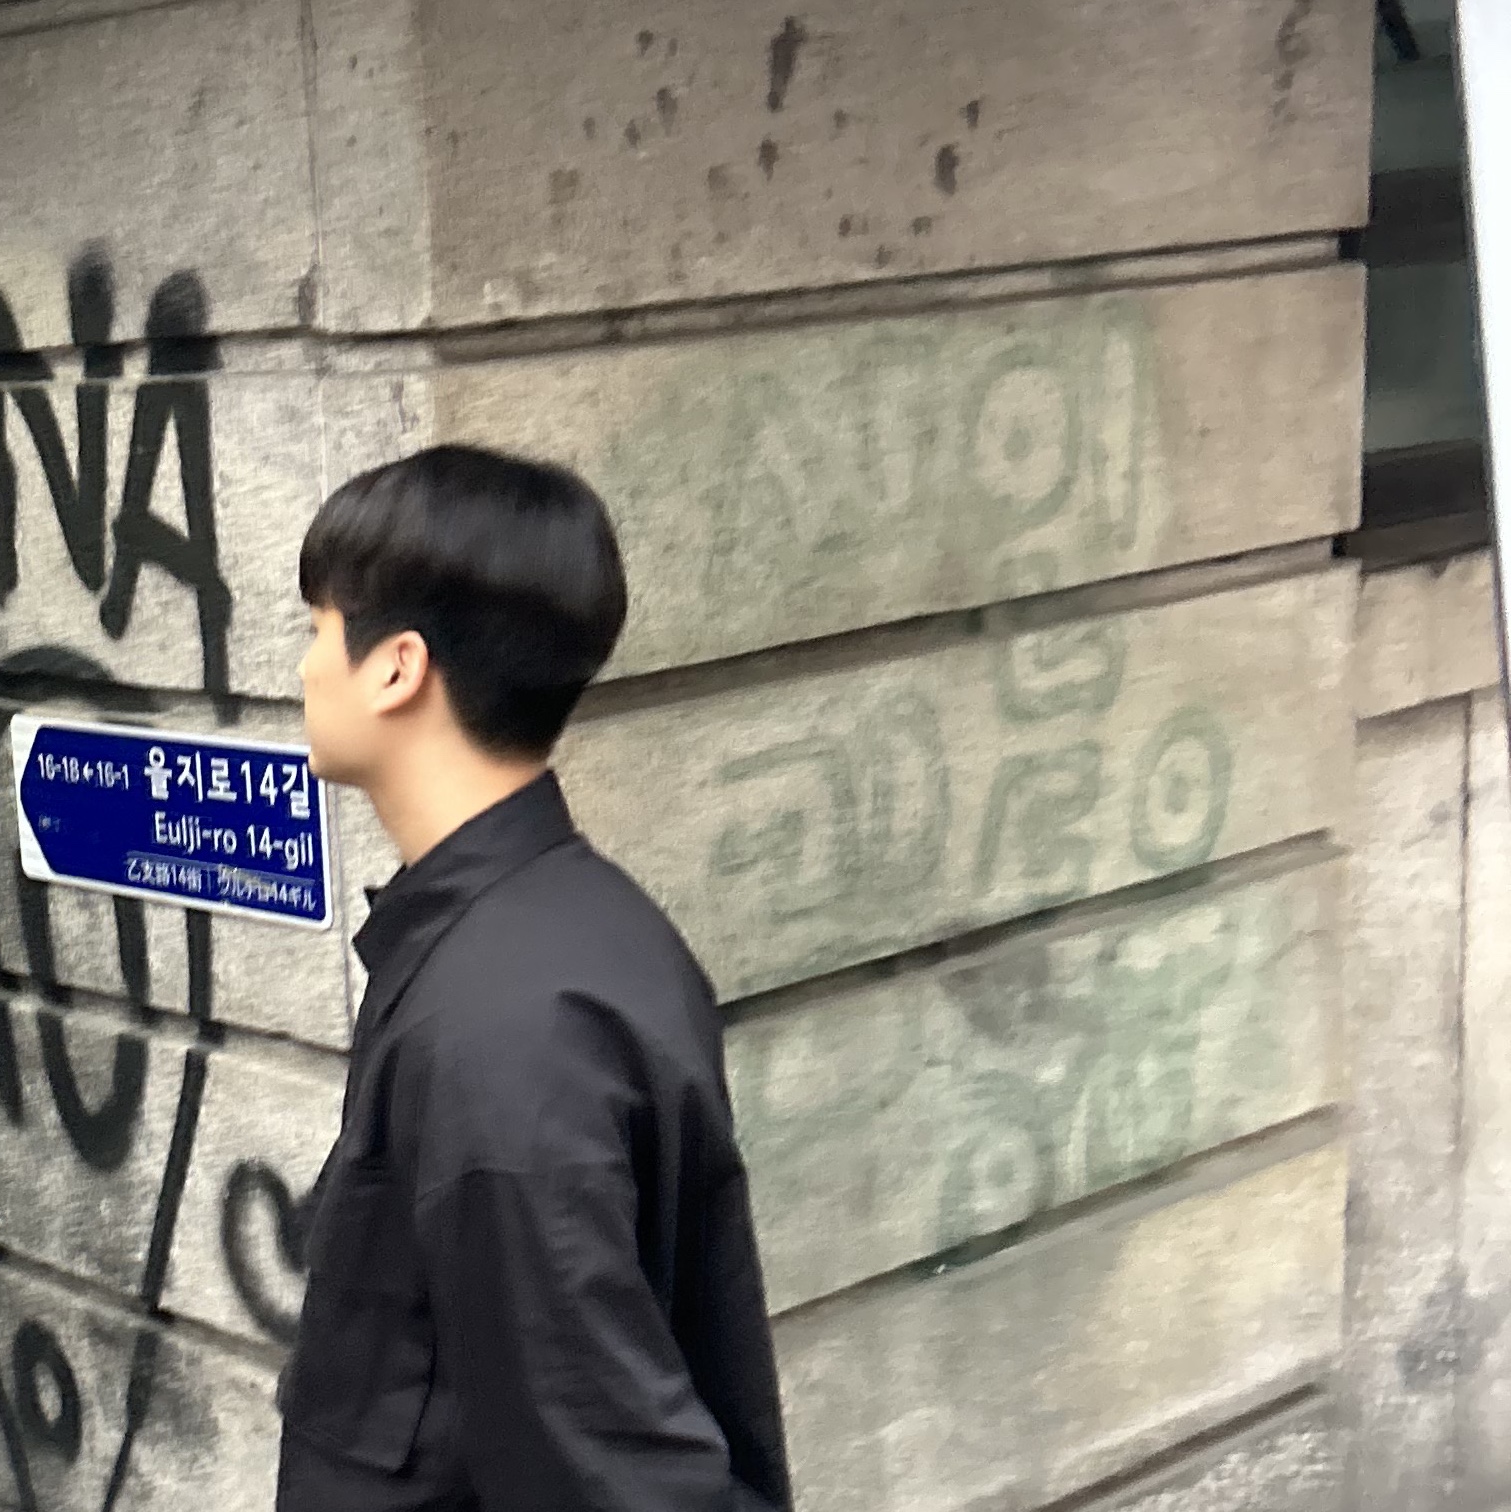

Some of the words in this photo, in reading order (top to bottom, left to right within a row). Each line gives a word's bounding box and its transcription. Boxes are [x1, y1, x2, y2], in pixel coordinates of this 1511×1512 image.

[144, 745, 311, 820] 을지로14길
[154, 810, 237, 856] Eulji-ro
[246, 823, 314, 871] 14-gil
